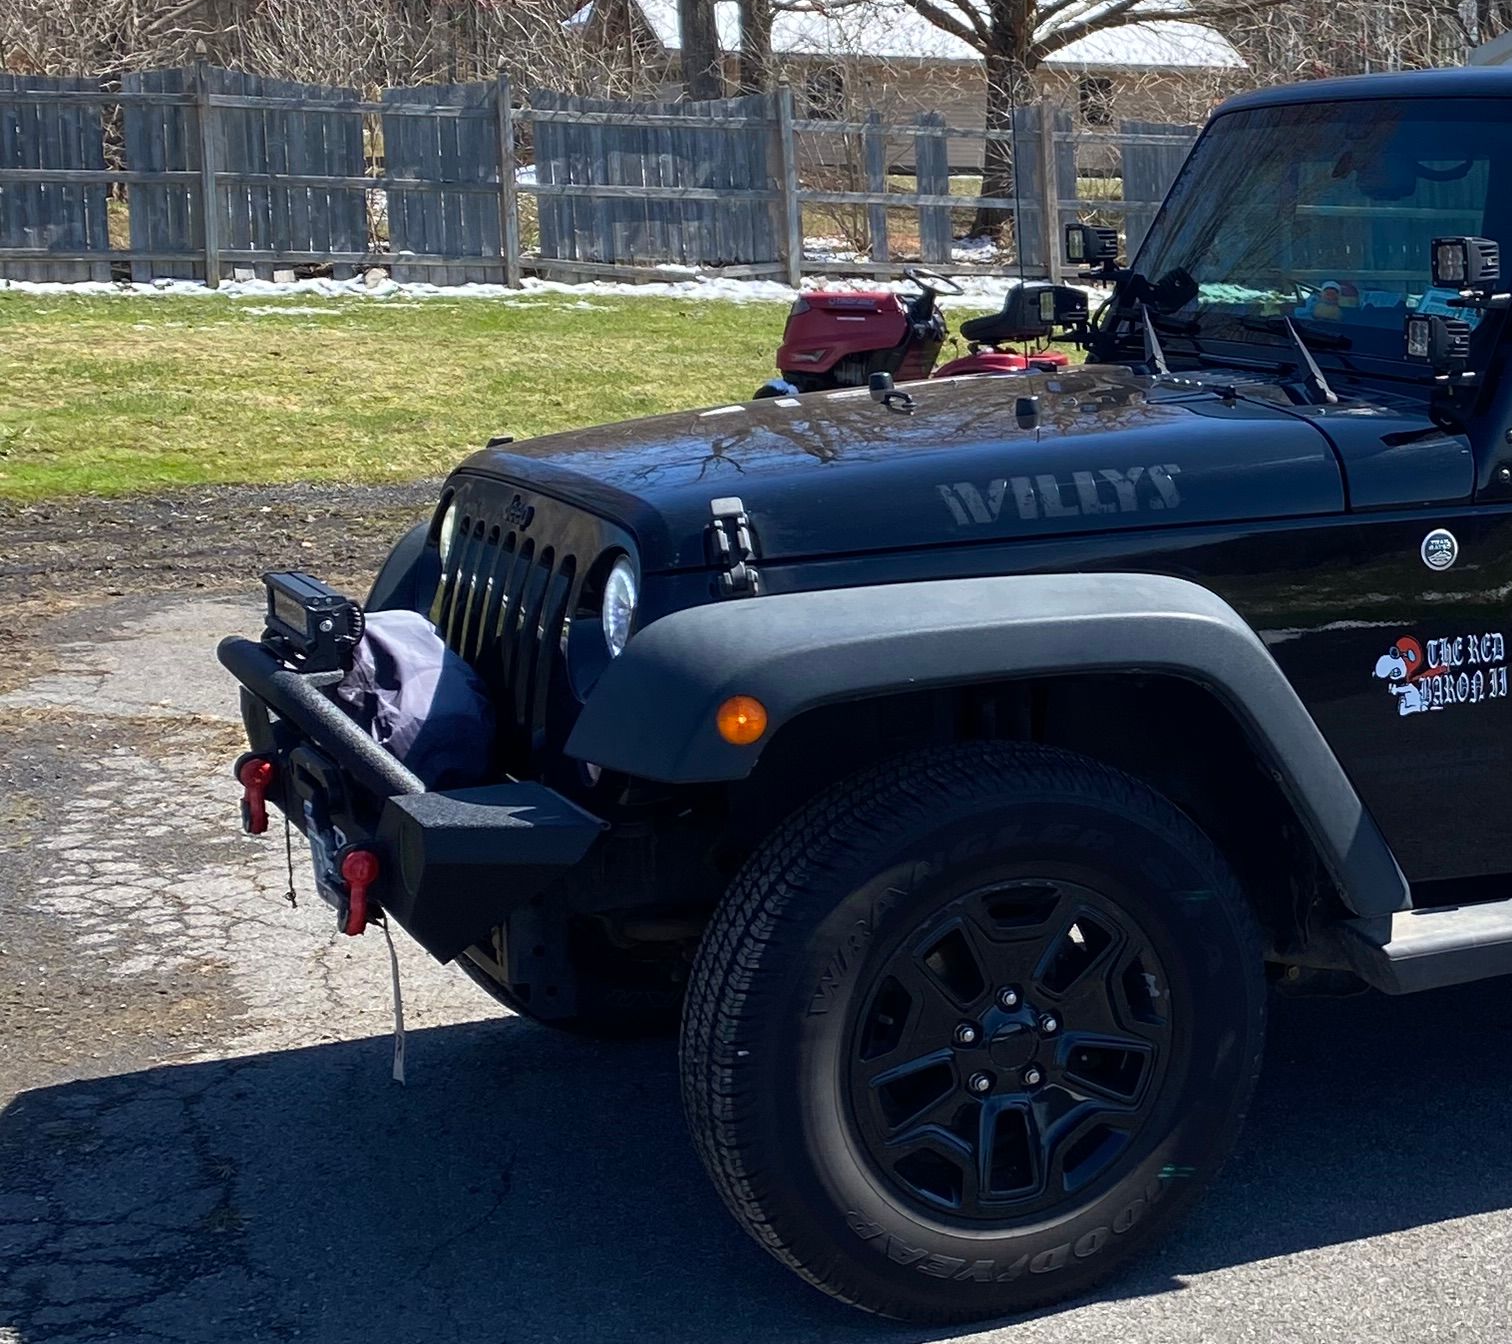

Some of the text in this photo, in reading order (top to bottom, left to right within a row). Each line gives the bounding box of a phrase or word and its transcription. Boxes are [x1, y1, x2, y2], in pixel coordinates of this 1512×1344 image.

[937, 464, 1183, 526] WILLYS
[1427, 632, 1505, 668] THE RED
[1419, 667, 1508, 705] BARON II
